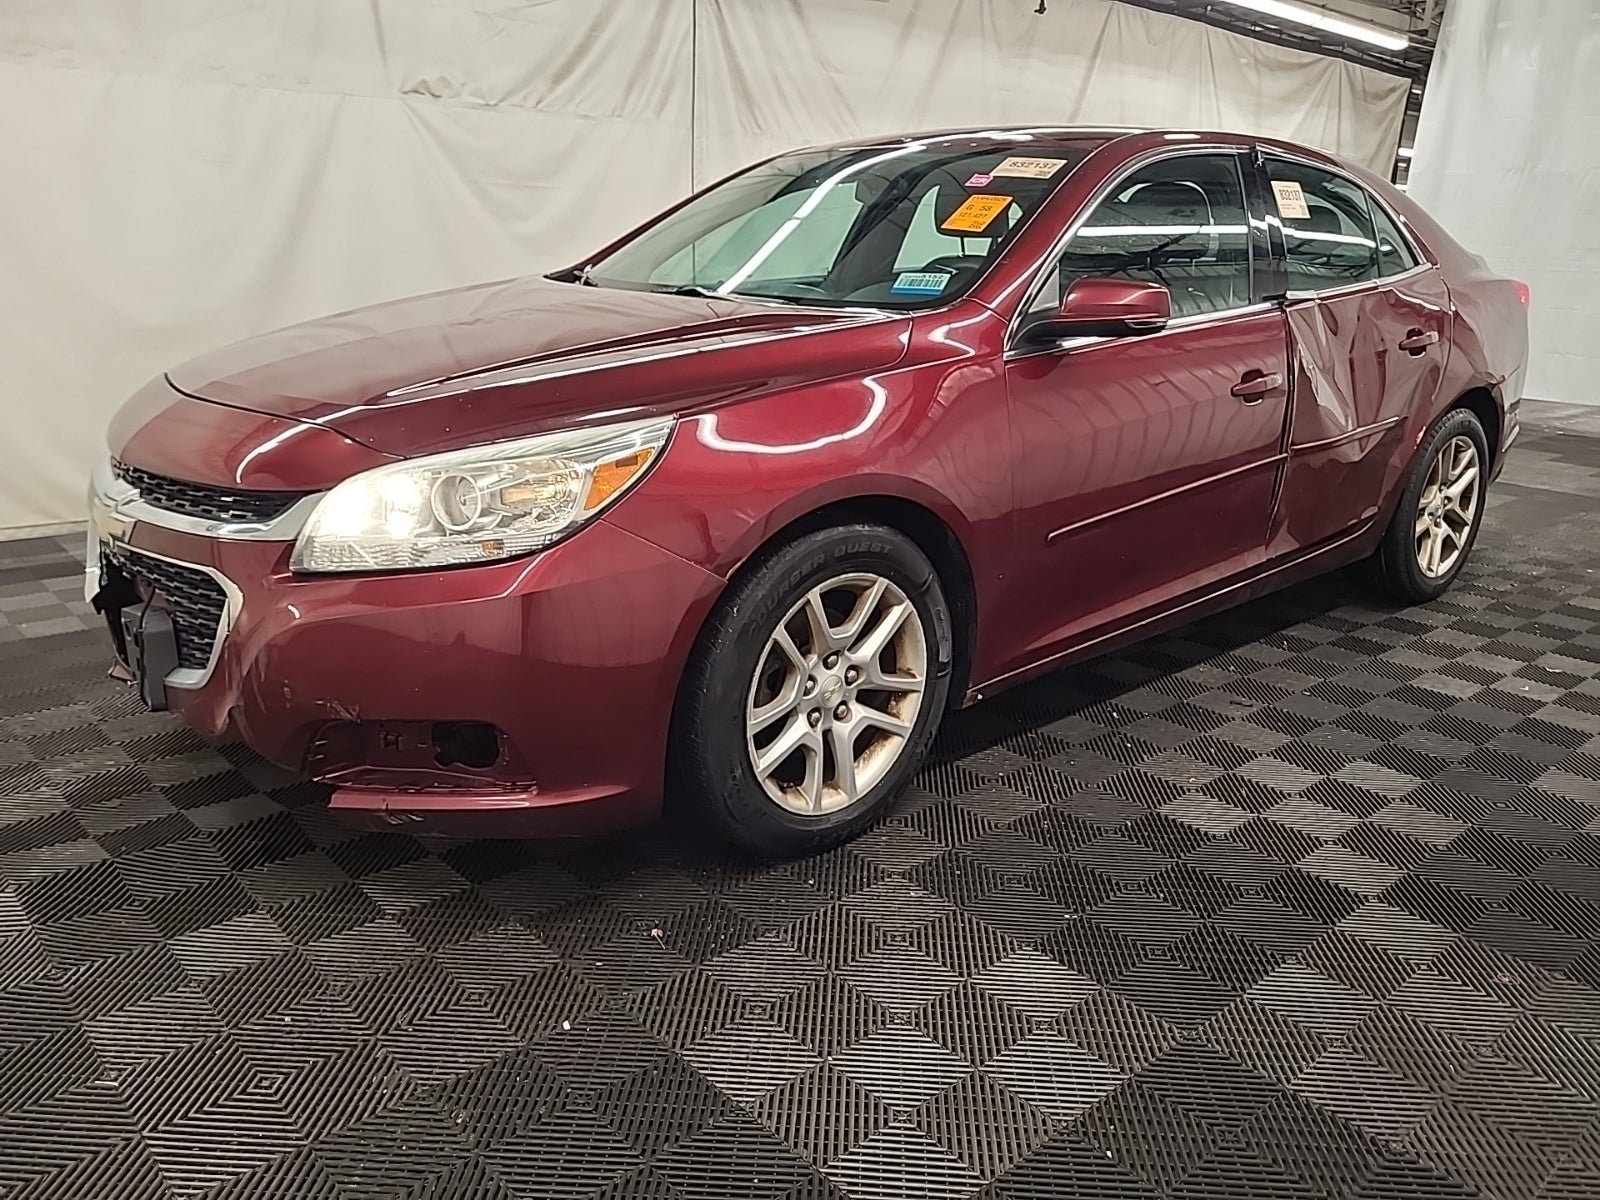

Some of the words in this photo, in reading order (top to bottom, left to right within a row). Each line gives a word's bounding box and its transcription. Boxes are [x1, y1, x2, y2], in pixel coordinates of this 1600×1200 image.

[1009, 161, 1058, 169] 832137
[1279, 189, 1301, 201] 832137
[749, 553, 826, 637] COURSER
[834, 542, 894, 557] QUEST
